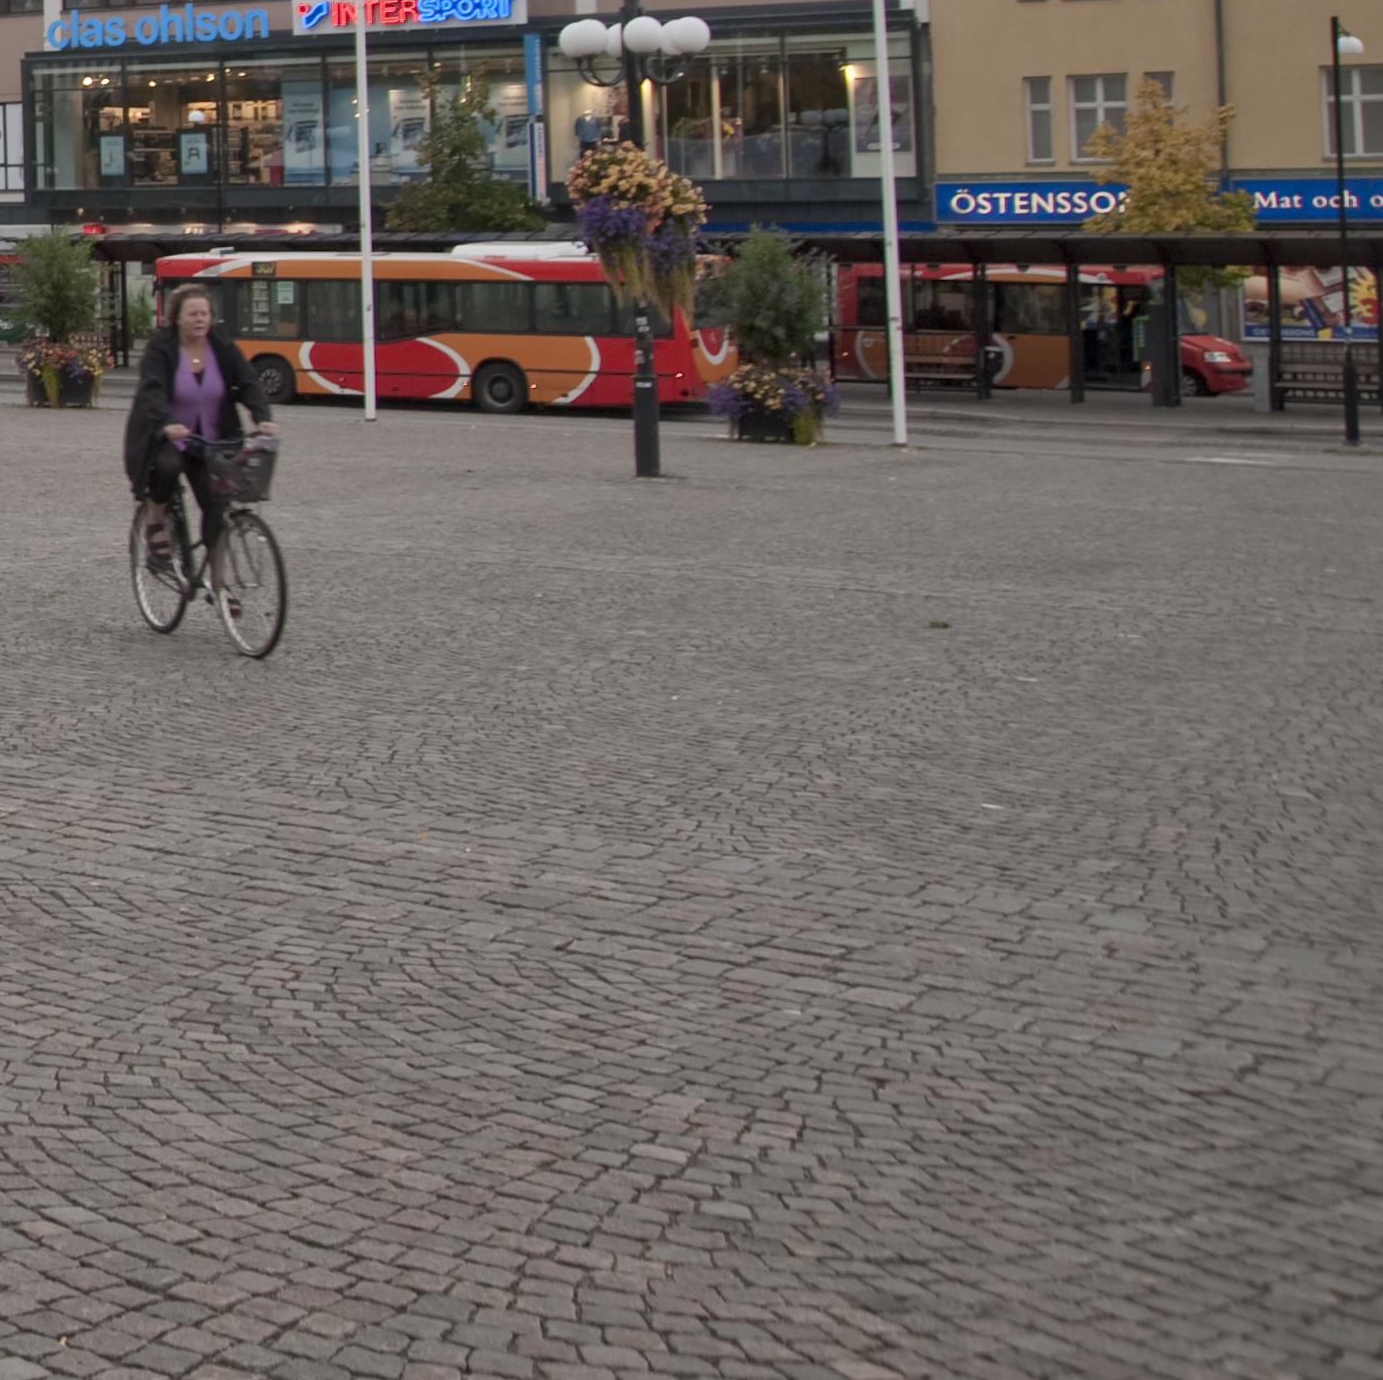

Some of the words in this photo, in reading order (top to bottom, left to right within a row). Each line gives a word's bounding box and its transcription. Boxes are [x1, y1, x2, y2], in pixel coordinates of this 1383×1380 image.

[46, 9, 127, 49] clas
[135, 2, 270, 45] ohlson
[1252, 191, 1303, 208] Mat
[1312, 189, 1359, 209] och
